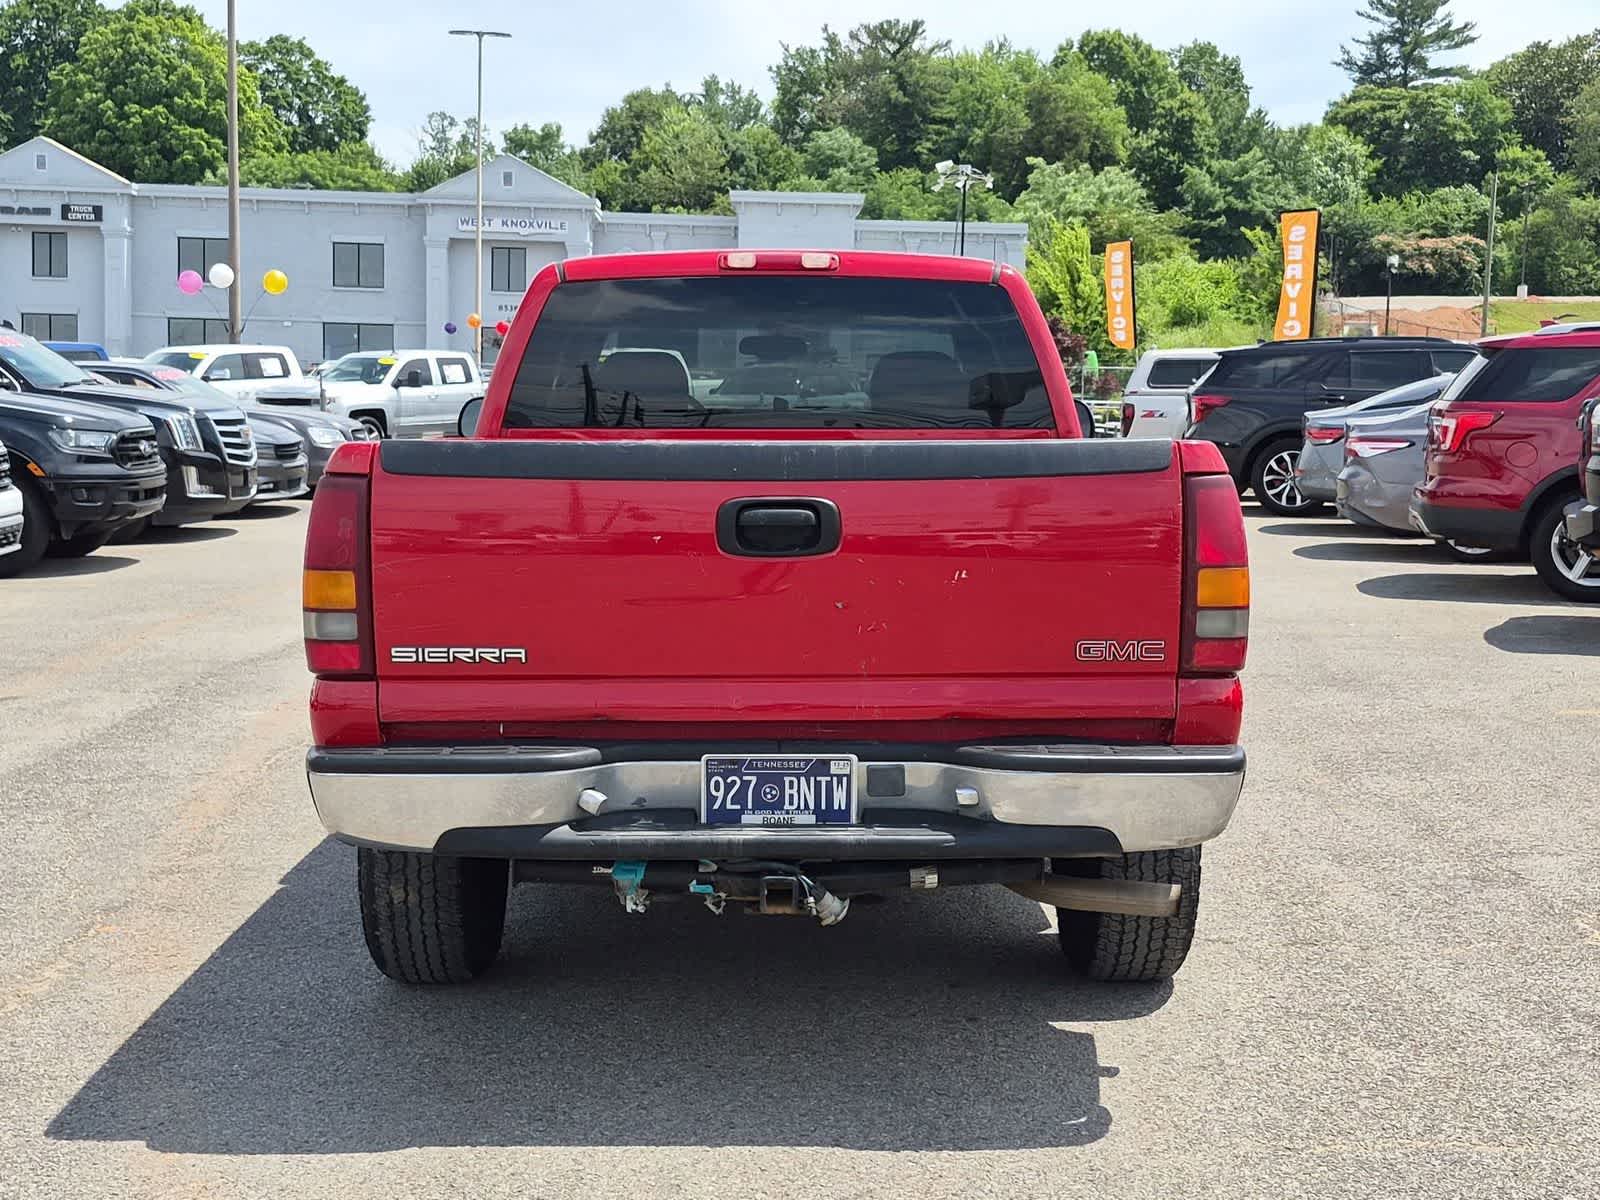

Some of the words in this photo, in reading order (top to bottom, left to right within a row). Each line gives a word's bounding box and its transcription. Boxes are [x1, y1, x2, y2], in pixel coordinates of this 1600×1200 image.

[69, 205, 93, 213] TRUCK
[67, 212, 95, 221] CENTER
[501, 219, 567, 231] KNOXVILLE
[391, 646, 527, 663] SIERRA
[1075, 639, 1165, 661] GMC
[751, 760, 807, 769] TENNESSEE
[709, 775, 757, 810] 927
[783, 776, 848, 810] BNTW
[762, 816, 796, 825] ROANE
